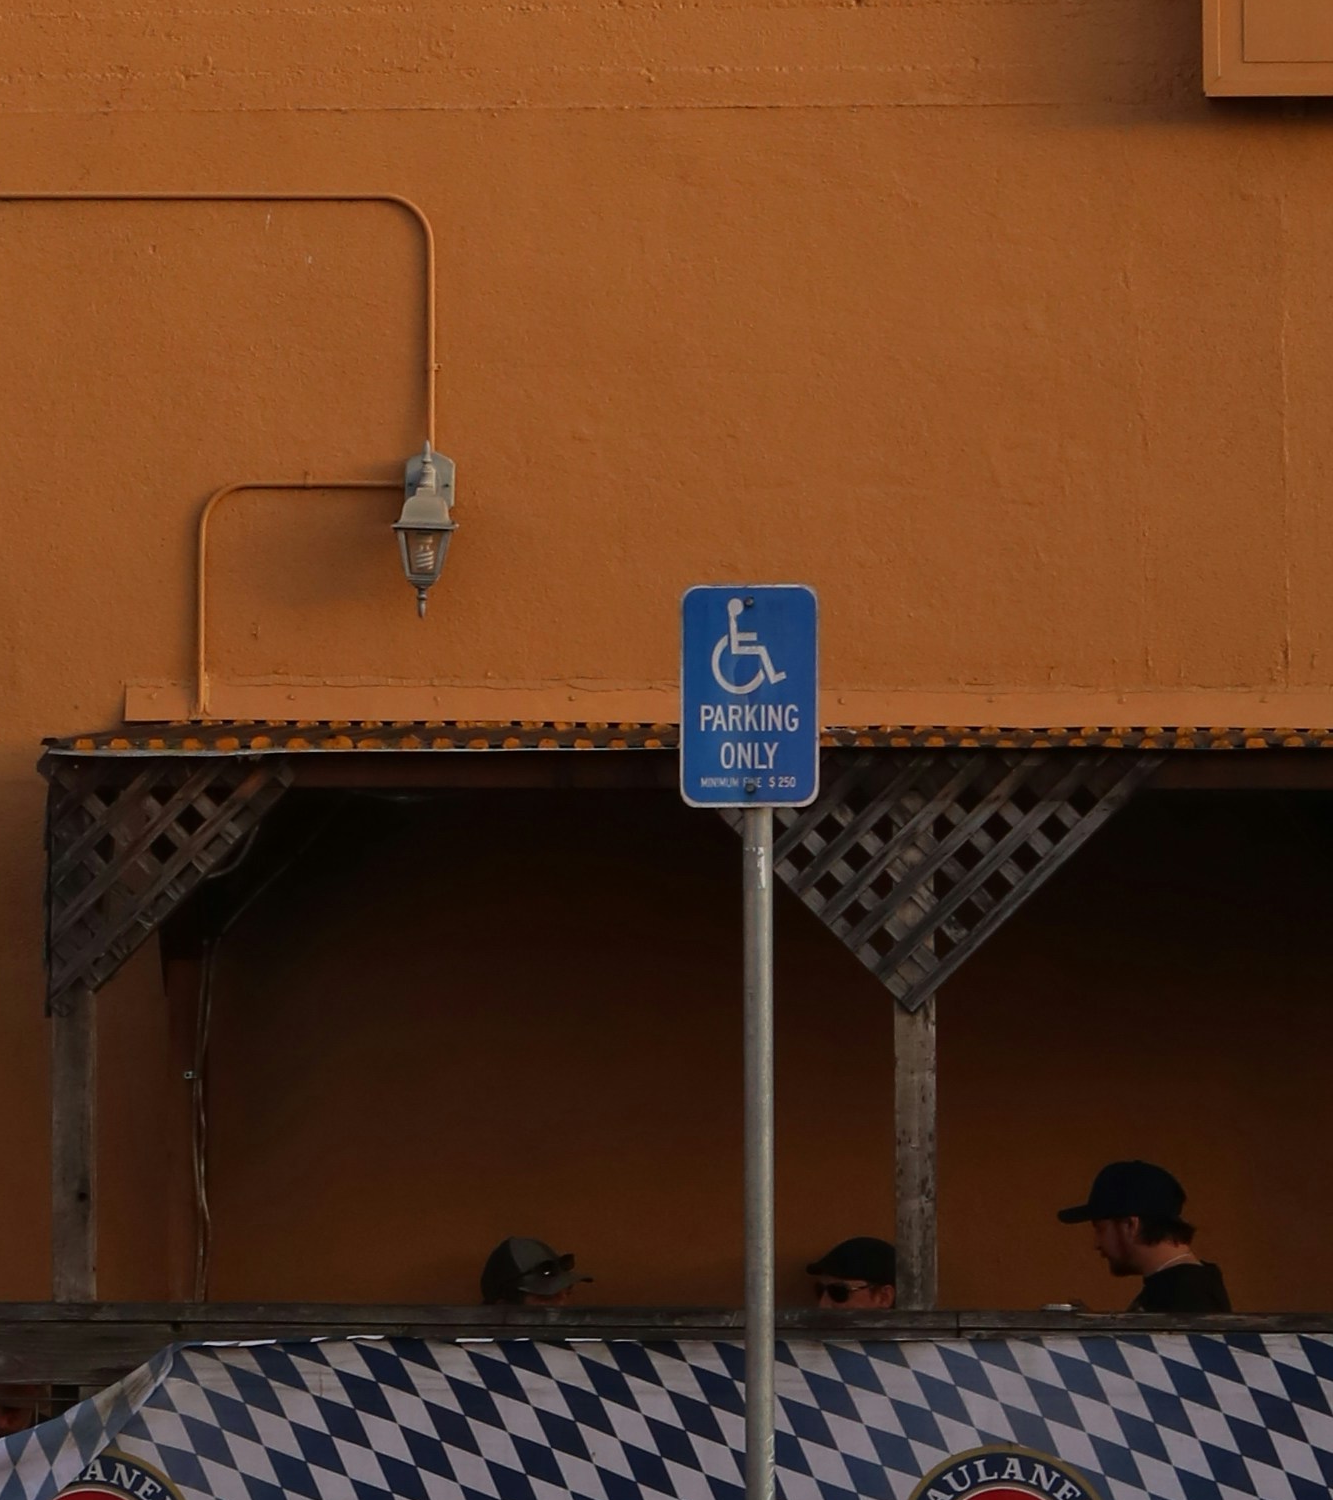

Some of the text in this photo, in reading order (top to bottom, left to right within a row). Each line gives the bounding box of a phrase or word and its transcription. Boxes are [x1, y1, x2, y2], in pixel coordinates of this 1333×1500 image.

[699, 703, 800, 732] PARKING
[719, 741, 779, 770] ONLY
[700, 777, 740, 788] MINIMUM
